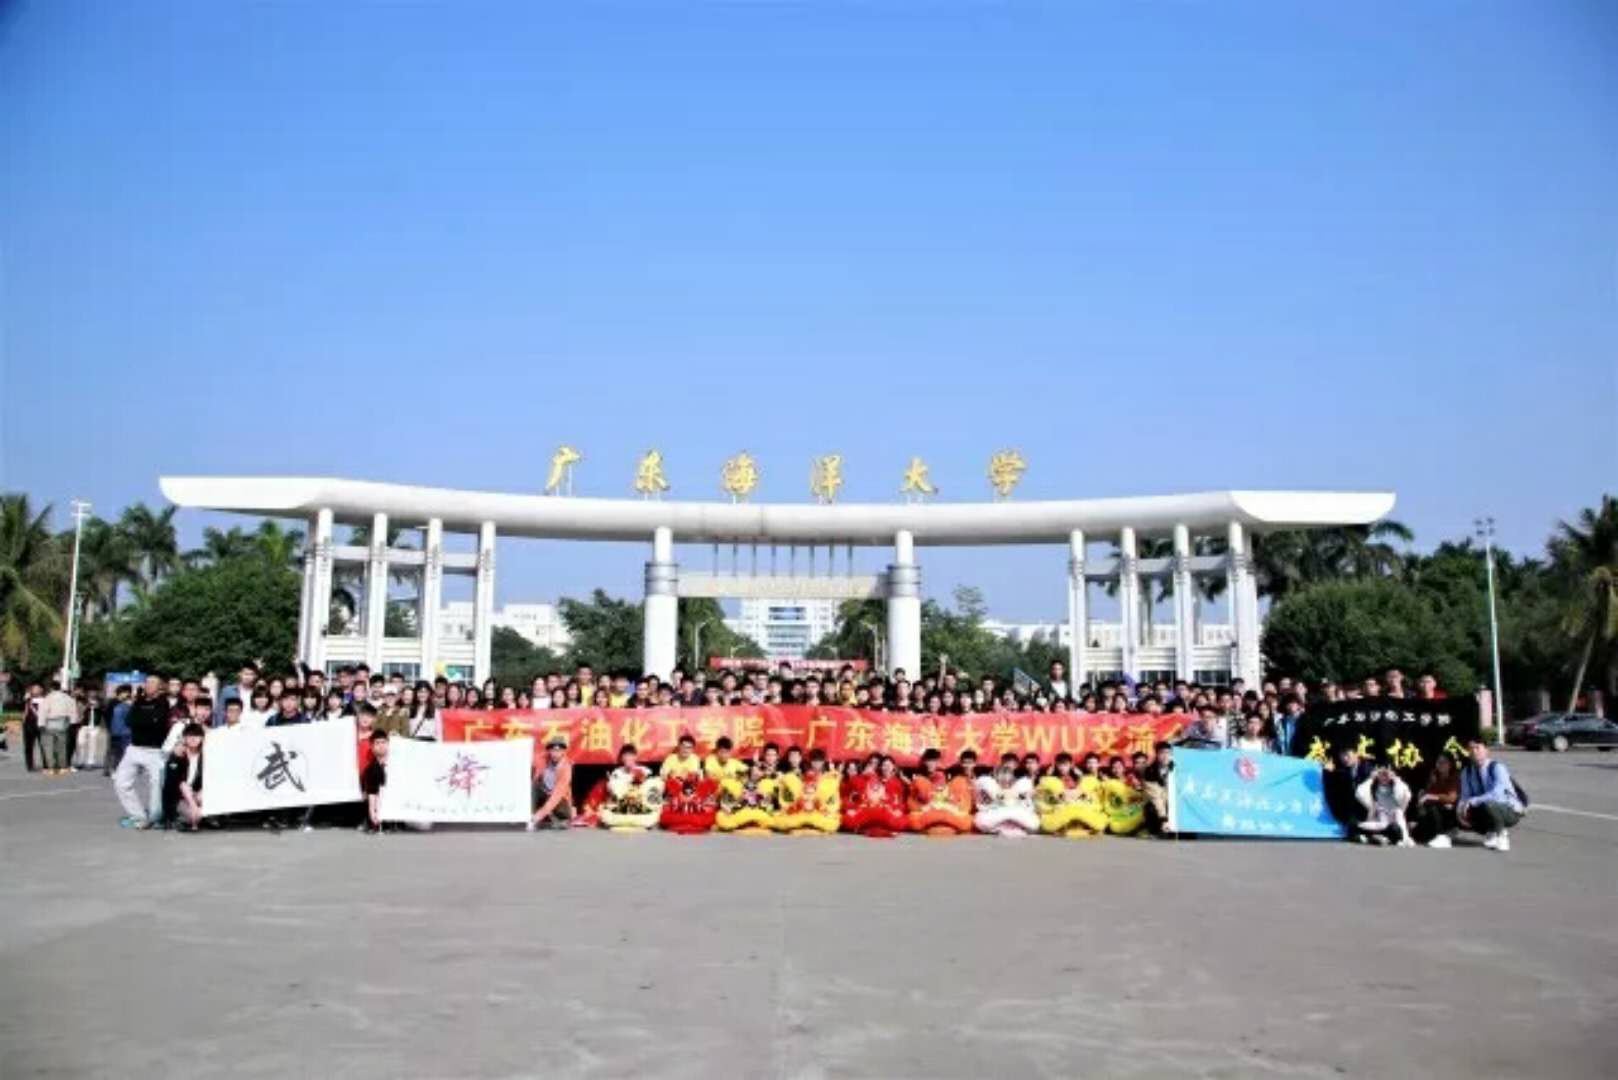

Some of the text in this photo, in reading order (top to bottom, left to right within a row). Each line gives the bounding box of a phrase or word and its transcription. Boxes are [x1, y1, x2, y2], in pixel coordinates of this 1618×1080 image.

[544, 444, 1026, 503] 广东海洋大学
[256, 741, 307, 793] 武
